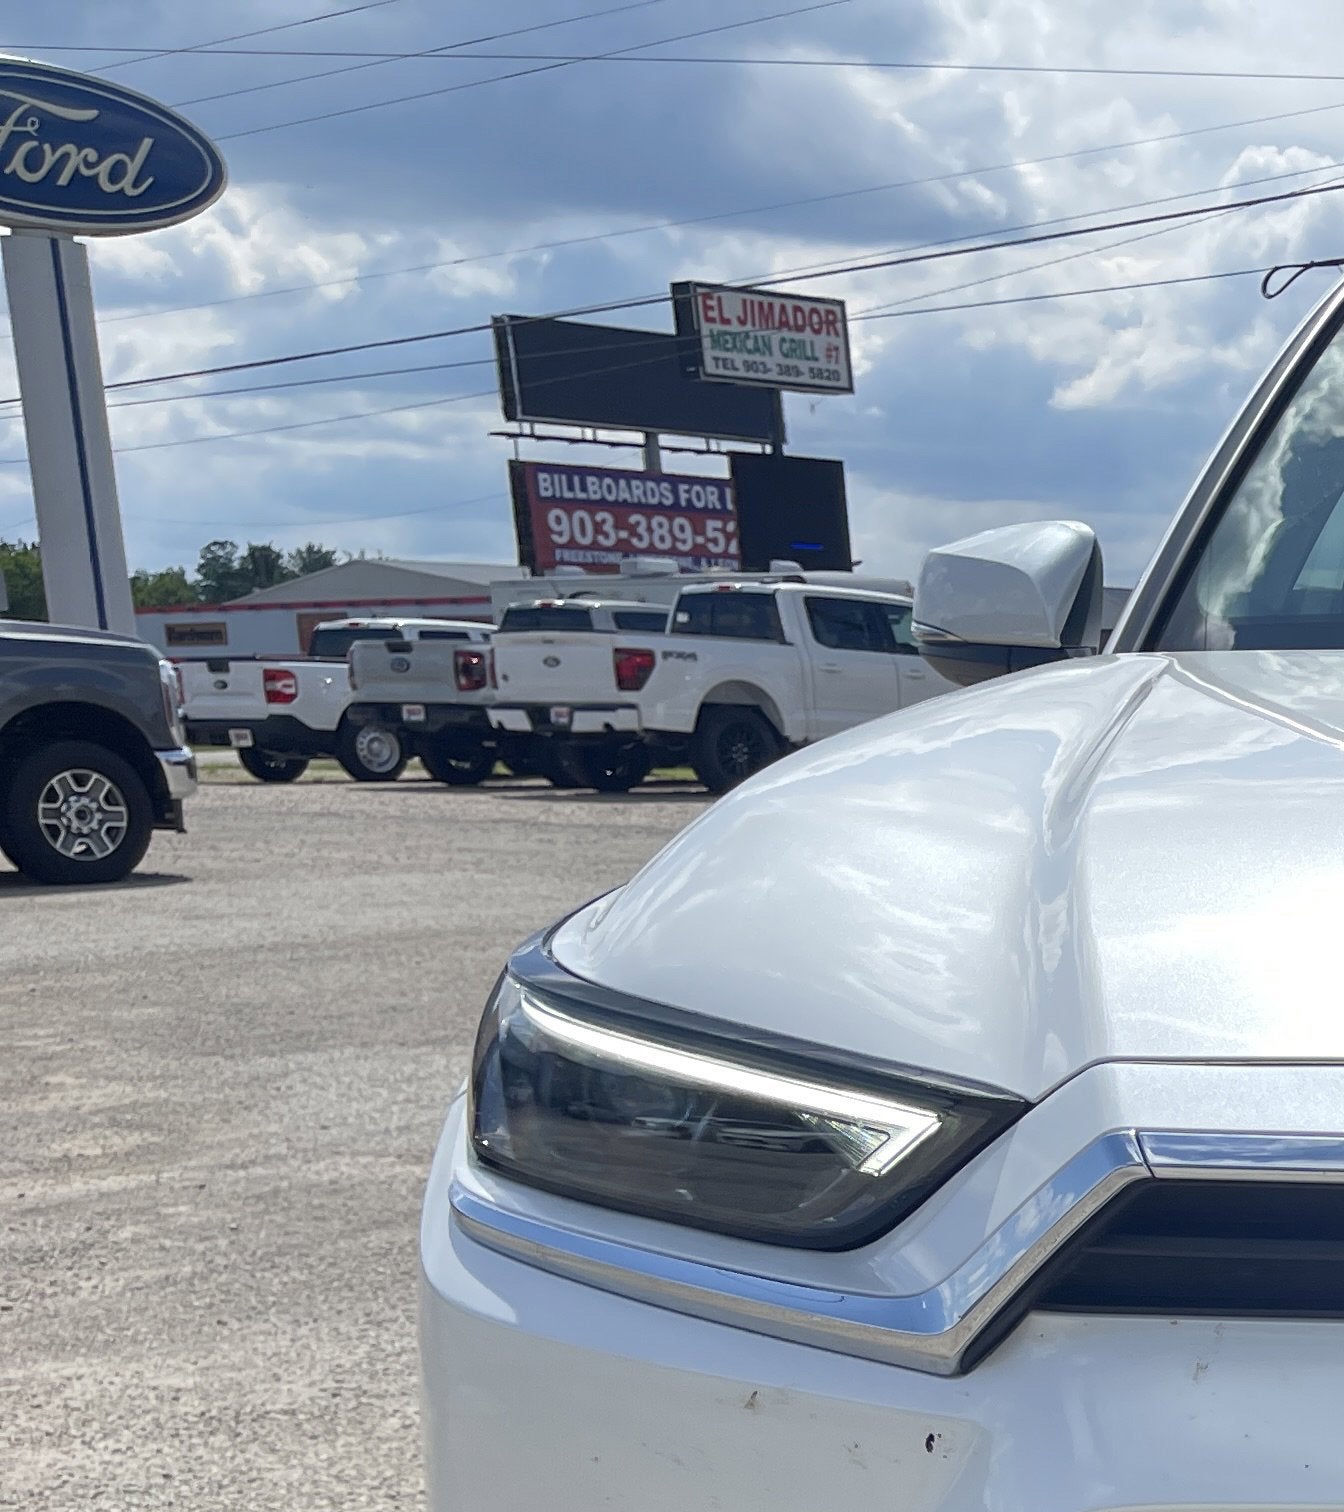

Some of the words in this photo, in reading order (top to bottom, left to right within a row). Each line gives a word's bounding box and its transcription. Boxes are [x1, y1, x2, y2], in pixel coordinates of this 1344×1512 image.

[0, 88, 155, 197] Ford
[701, 291, 731, 326] EL
[736, 298, 841, 338] JIMADOR
[709, 328, 773, 357] MEXICAN
[778, 336, 819, 362] GRILL
[711, 356, 739, 372] TEL
[536, 472, 674, 506] BILLBOARDS
[677, 483, 721, 510] FOR
